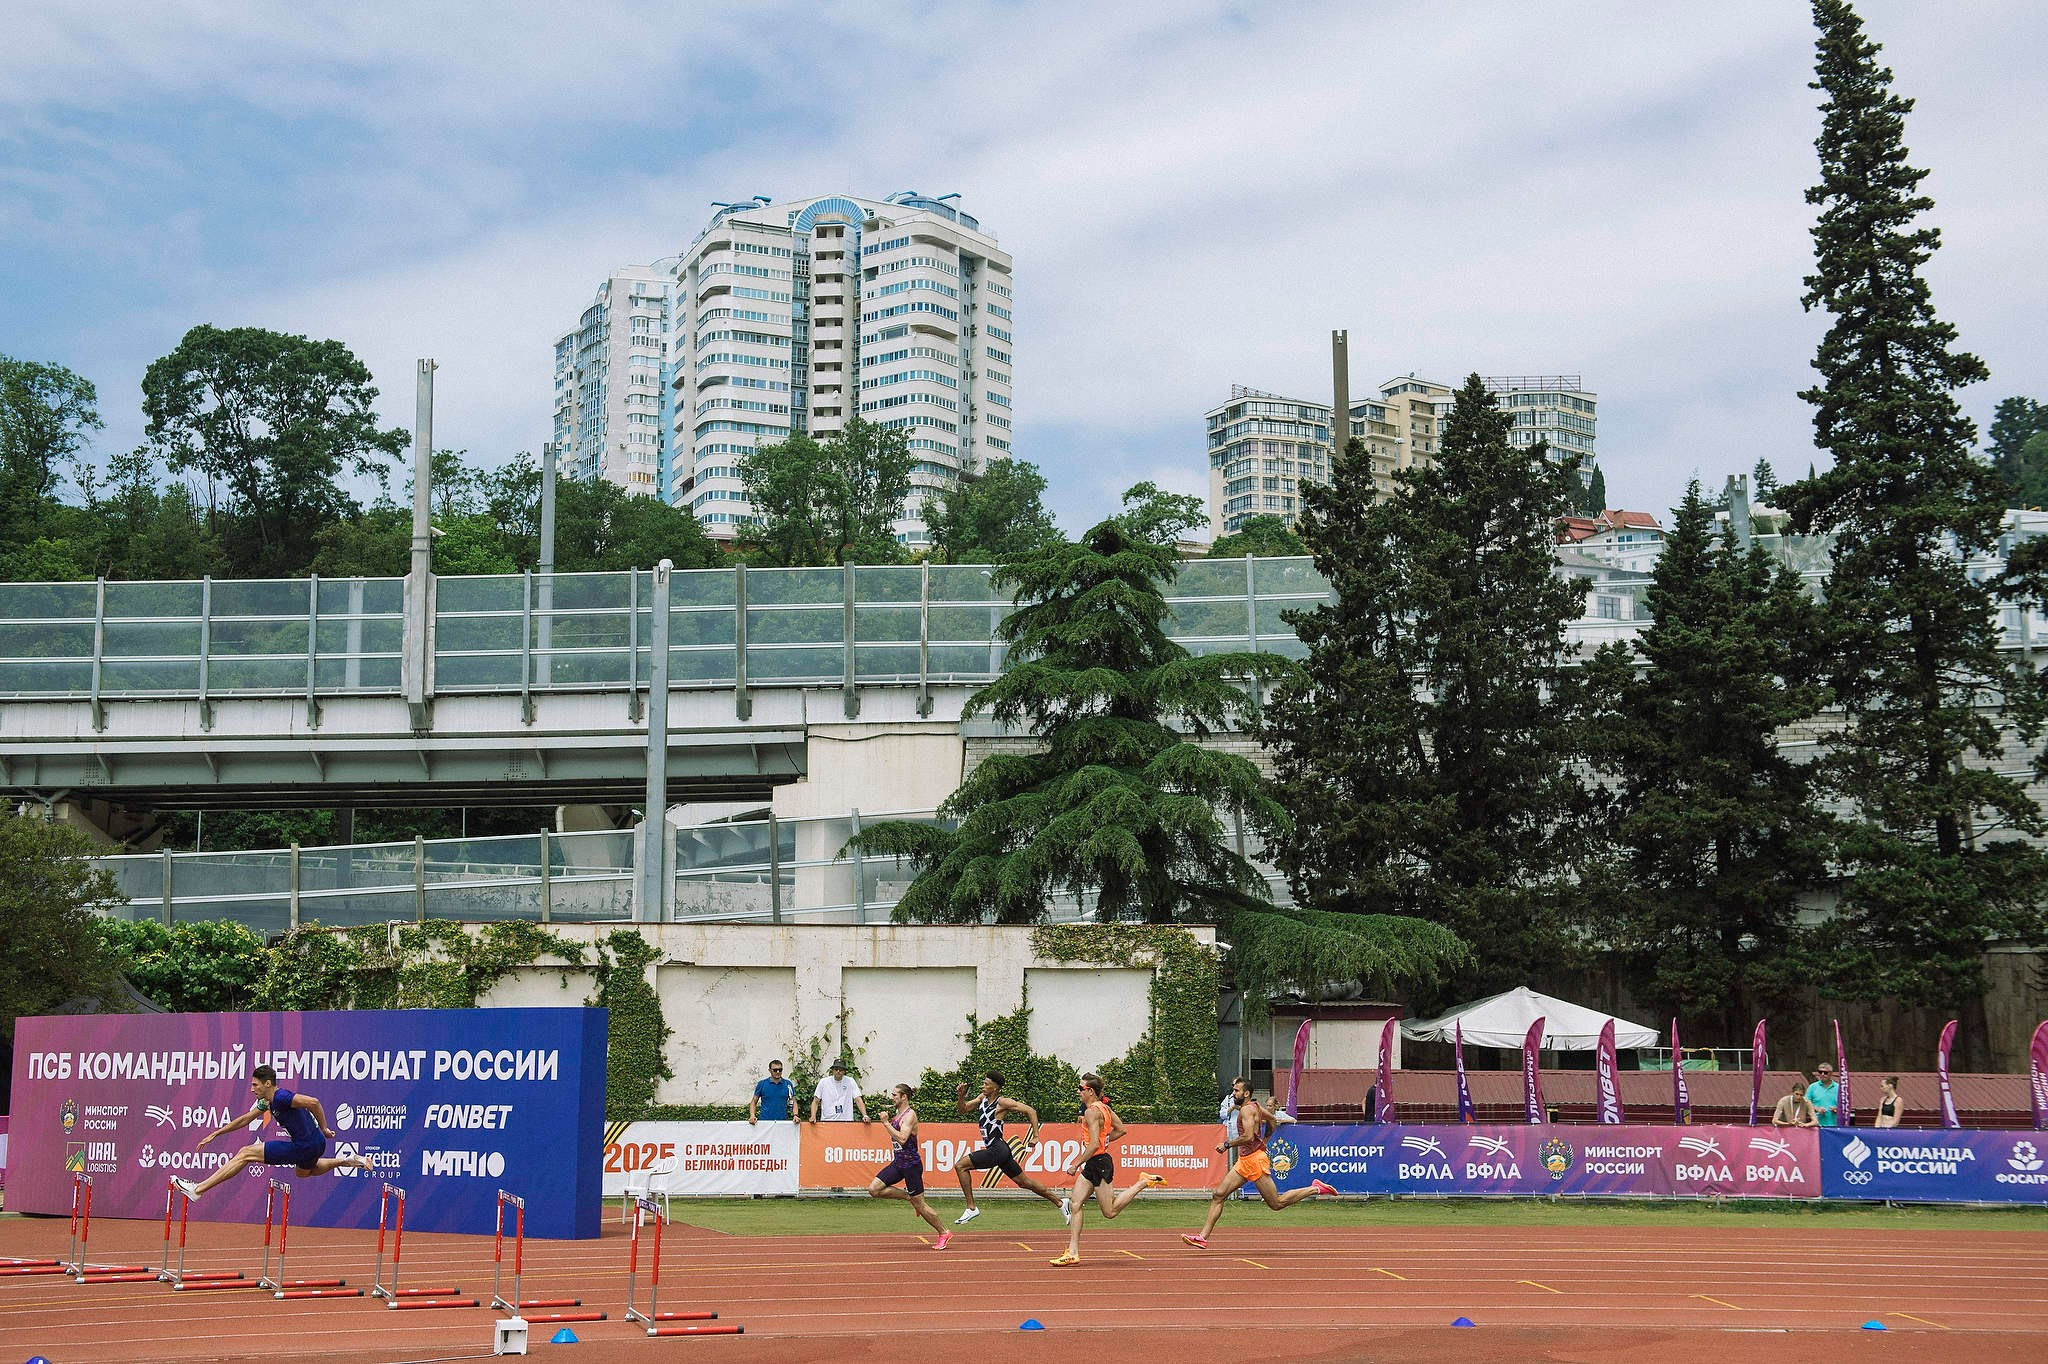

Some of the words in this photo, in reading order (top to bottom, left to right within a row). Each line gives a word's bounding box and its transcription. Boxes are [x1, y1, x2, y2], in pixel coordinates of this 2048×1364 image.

[28, 1052, 71, 1079] ПСБ
[78, 1043, 245, 1085] КОМАНДНЫЙ
[433, 1049, 558, 1080] РОССИИ
[84, 1105, 128, 1116] МИНСПОРТ
[356, 1104, 406, 1114] БАЛТИЙСКИЙ
[182, 1106, 231, 1127] ВФЛА
[355, 1115, 406, 1129] ЛИЗИНГ
[424, 1104, 512, 1129] FONBET
[84, 1119, 116, 1129] РОССИИ
[88, 1141, 117, 1160] URAL
[685, 1144, 693, 1155] С
[696, 1143, 770, 1157] ПРАЗДНИКОМ
[824, 1146, 842, 1162] 80
[1024, 1140, 1086, 1171] 202
[1120, 1144, 1127, 1154] С
[1129, 1144, 1193, 1156] ПРАЗДНИКОМ
[1309, 1145, 1384, 1157] МИНСПОРТ
[1584, 1146, 1662, 1158] МИНСПОРТ
[1876, 1146, 1975, 1161] КОМАНДА
[158, 1151, 228, 1168] ФОСАГРО
[685, 1158, 735, 1170] ВЕЛИКОЙ
[739, 1159, 787, 1171] ПОБЕДЫ!
[1120, 1156, 1163, 1167] ВЕЛИКОЙ
[1166, 1157, 1208, 1168] ПОБЕДЫ!
[87, 1163, 116, 1172] LOGISTICS
[1310, 1161, 1366, 1173] РОССИИ
[1399, 1162, 1453, 1179] ВФЛА
[1466, 1162, 1521, 1179] ВФЛА
[1585, 1162, 1644, 1174] РОССИИ
[1675, 1164, 1733, 1181] ВФЛА
[1745, 1164, 1804, 1182] ВФЛА
[1878, 1161, 1957, 1174] РОССИИ
